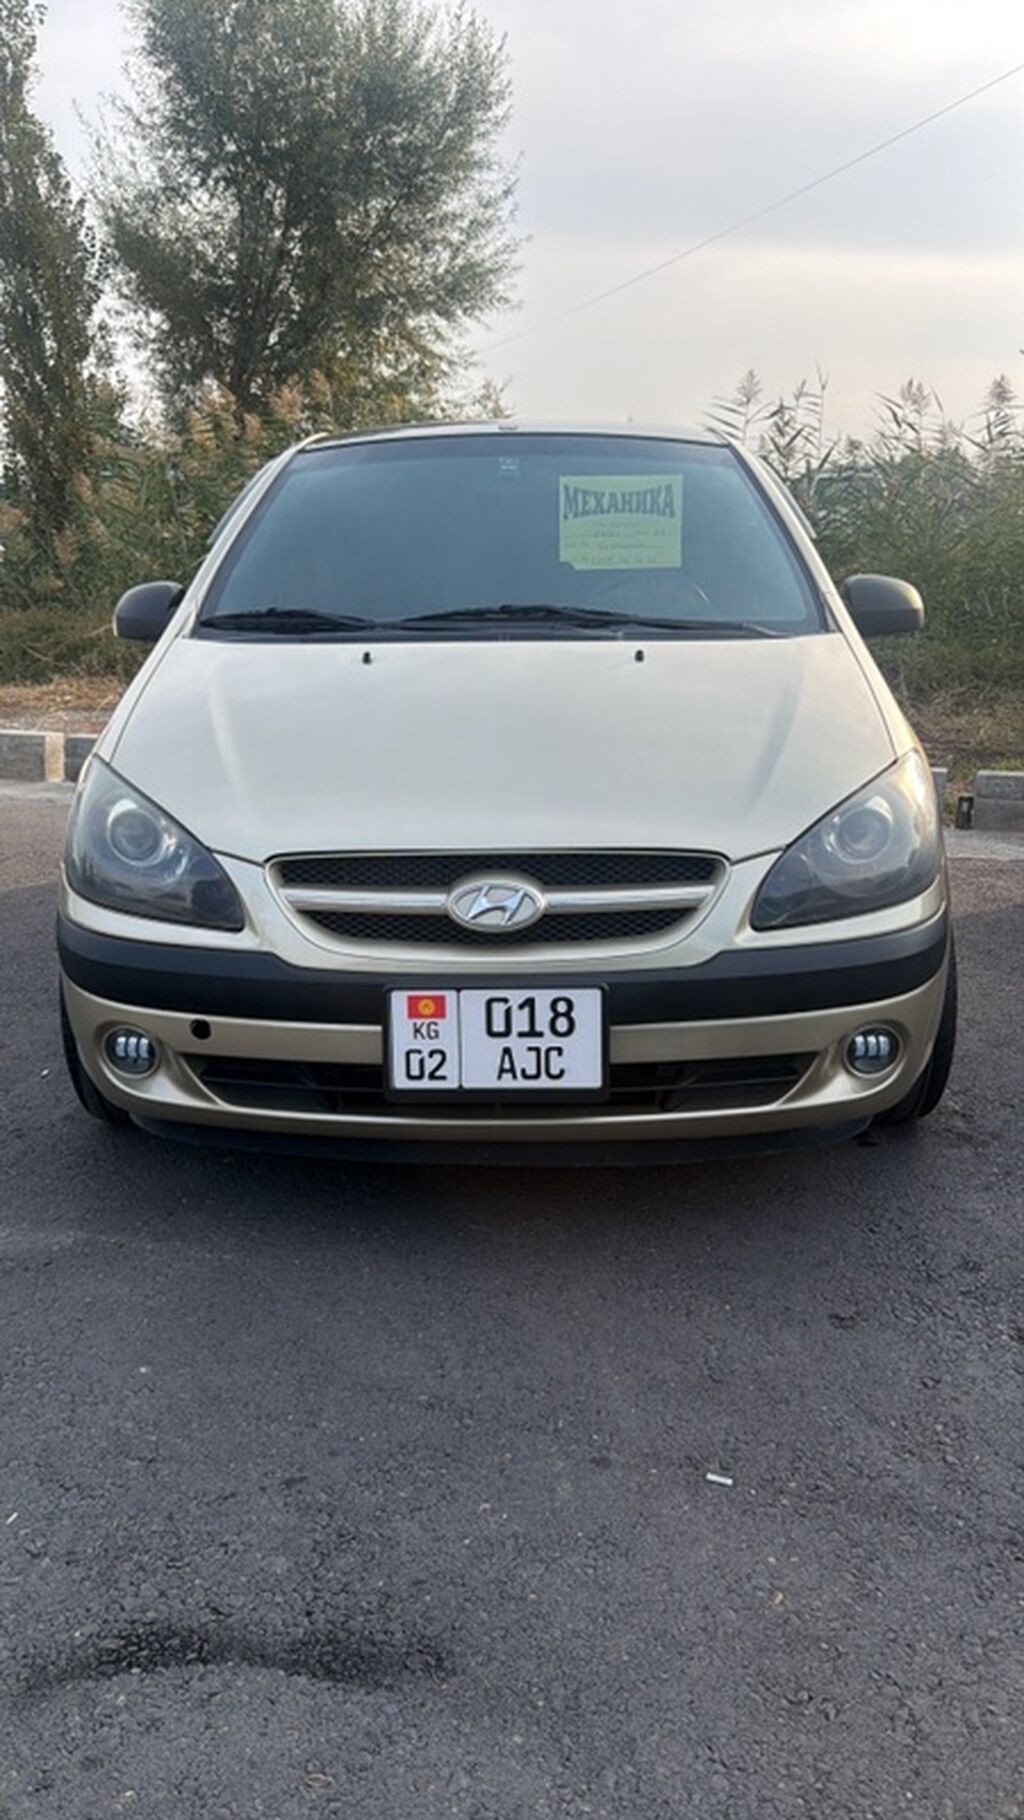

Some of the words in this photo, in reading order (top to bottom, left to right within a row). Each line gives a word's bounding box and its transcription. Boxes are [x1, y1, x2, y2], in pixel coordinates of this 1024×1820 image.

[563, 483, 676, 520] МЕХАНИКА
[413, 1022, 440, 1041] KG
[485, 997, 576, 1039] 018
[405, 1048, 448, 1081] 02
[497, 1047, 566, 1081] AJC
